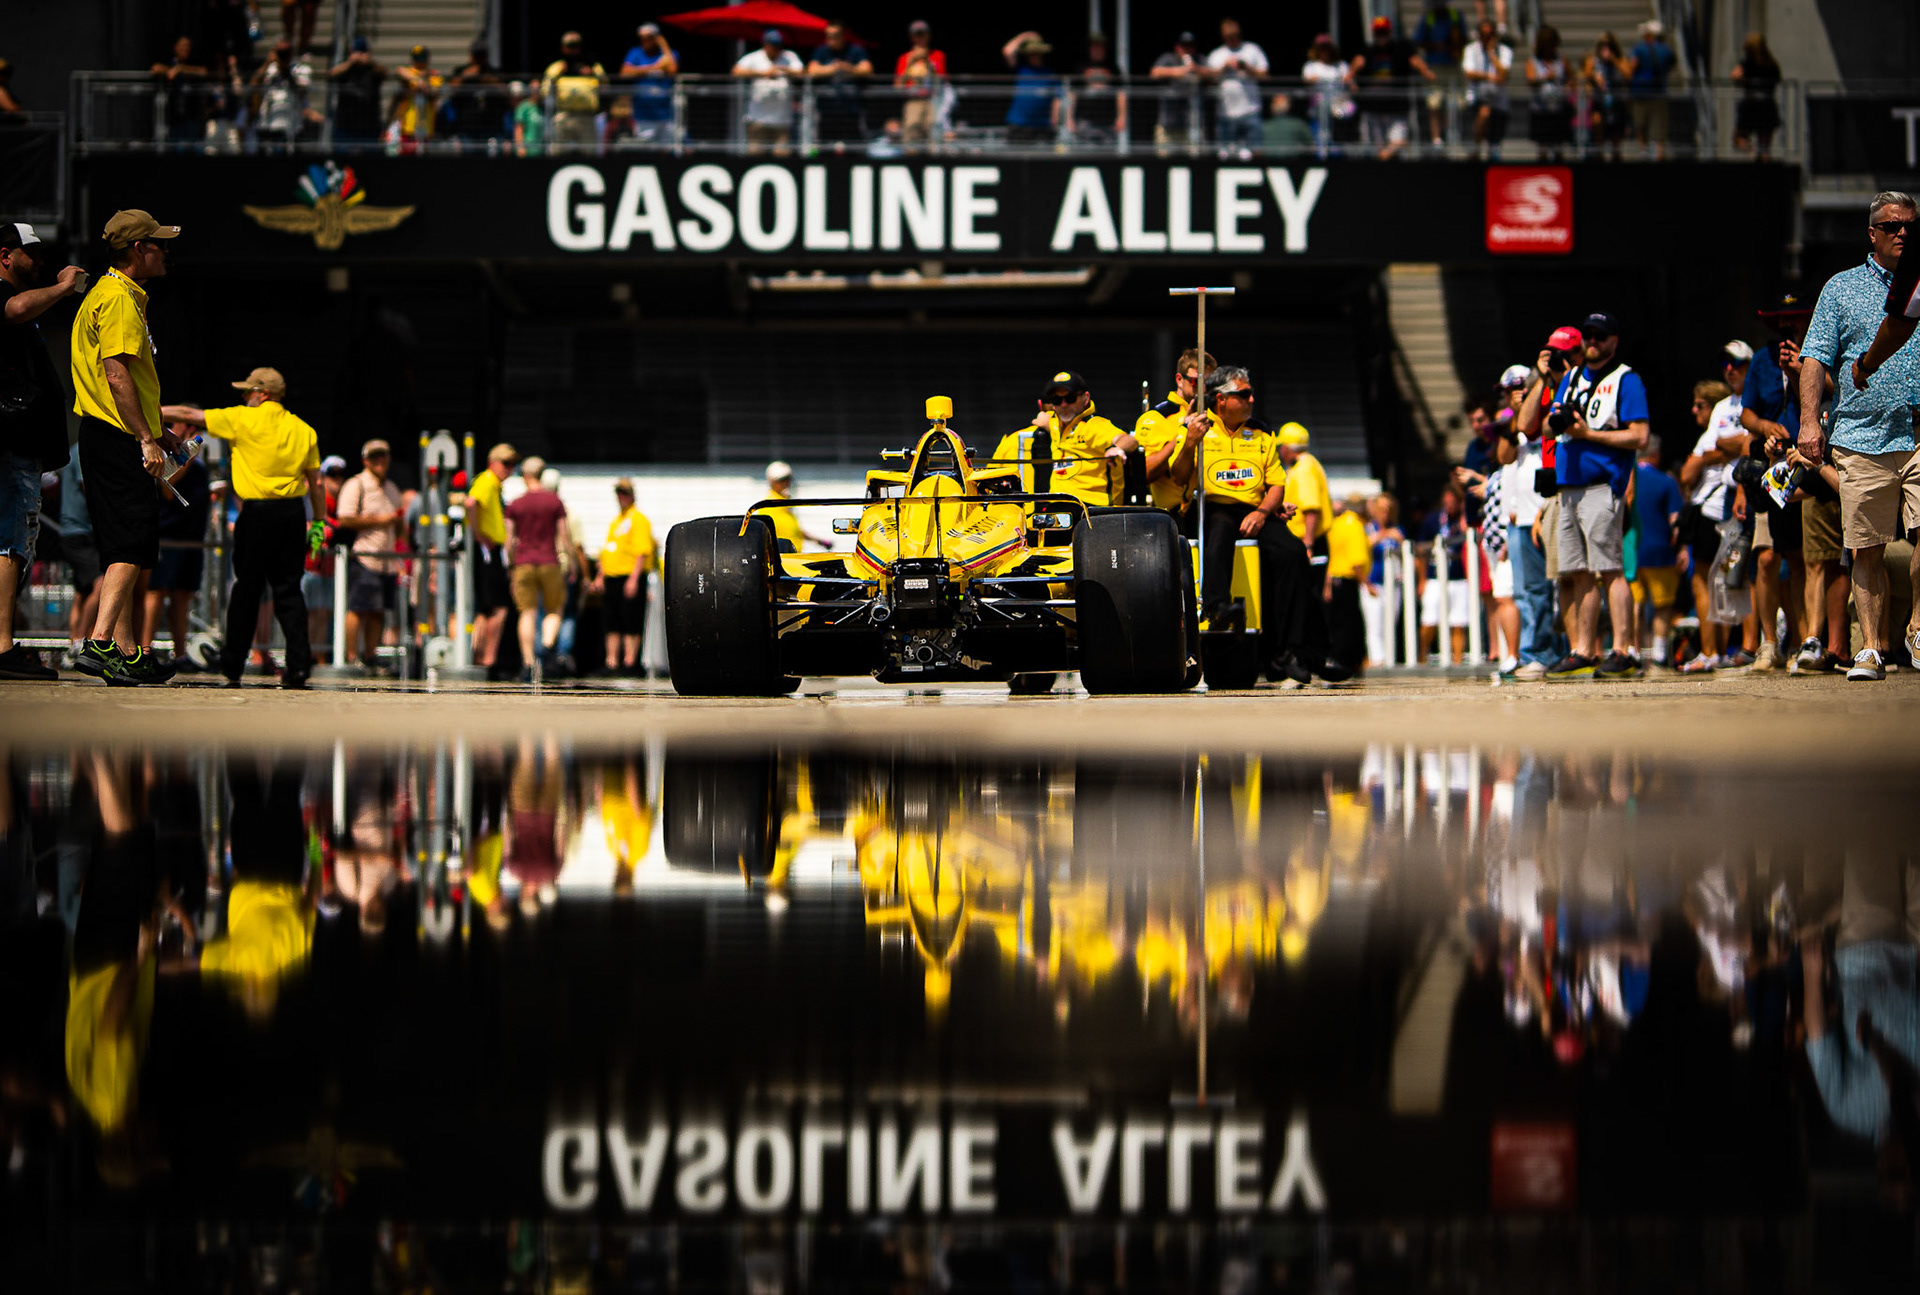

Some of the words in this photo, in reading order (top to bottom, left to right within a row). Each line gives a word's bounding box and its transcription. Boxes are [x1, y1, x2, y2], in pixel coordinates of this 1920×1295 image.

[547, 165, 1001, 252] GASOLINE
[1051, 166, 1328, 252] ALLEY
[1216, 467, 1254, 481] PENNZOIL
